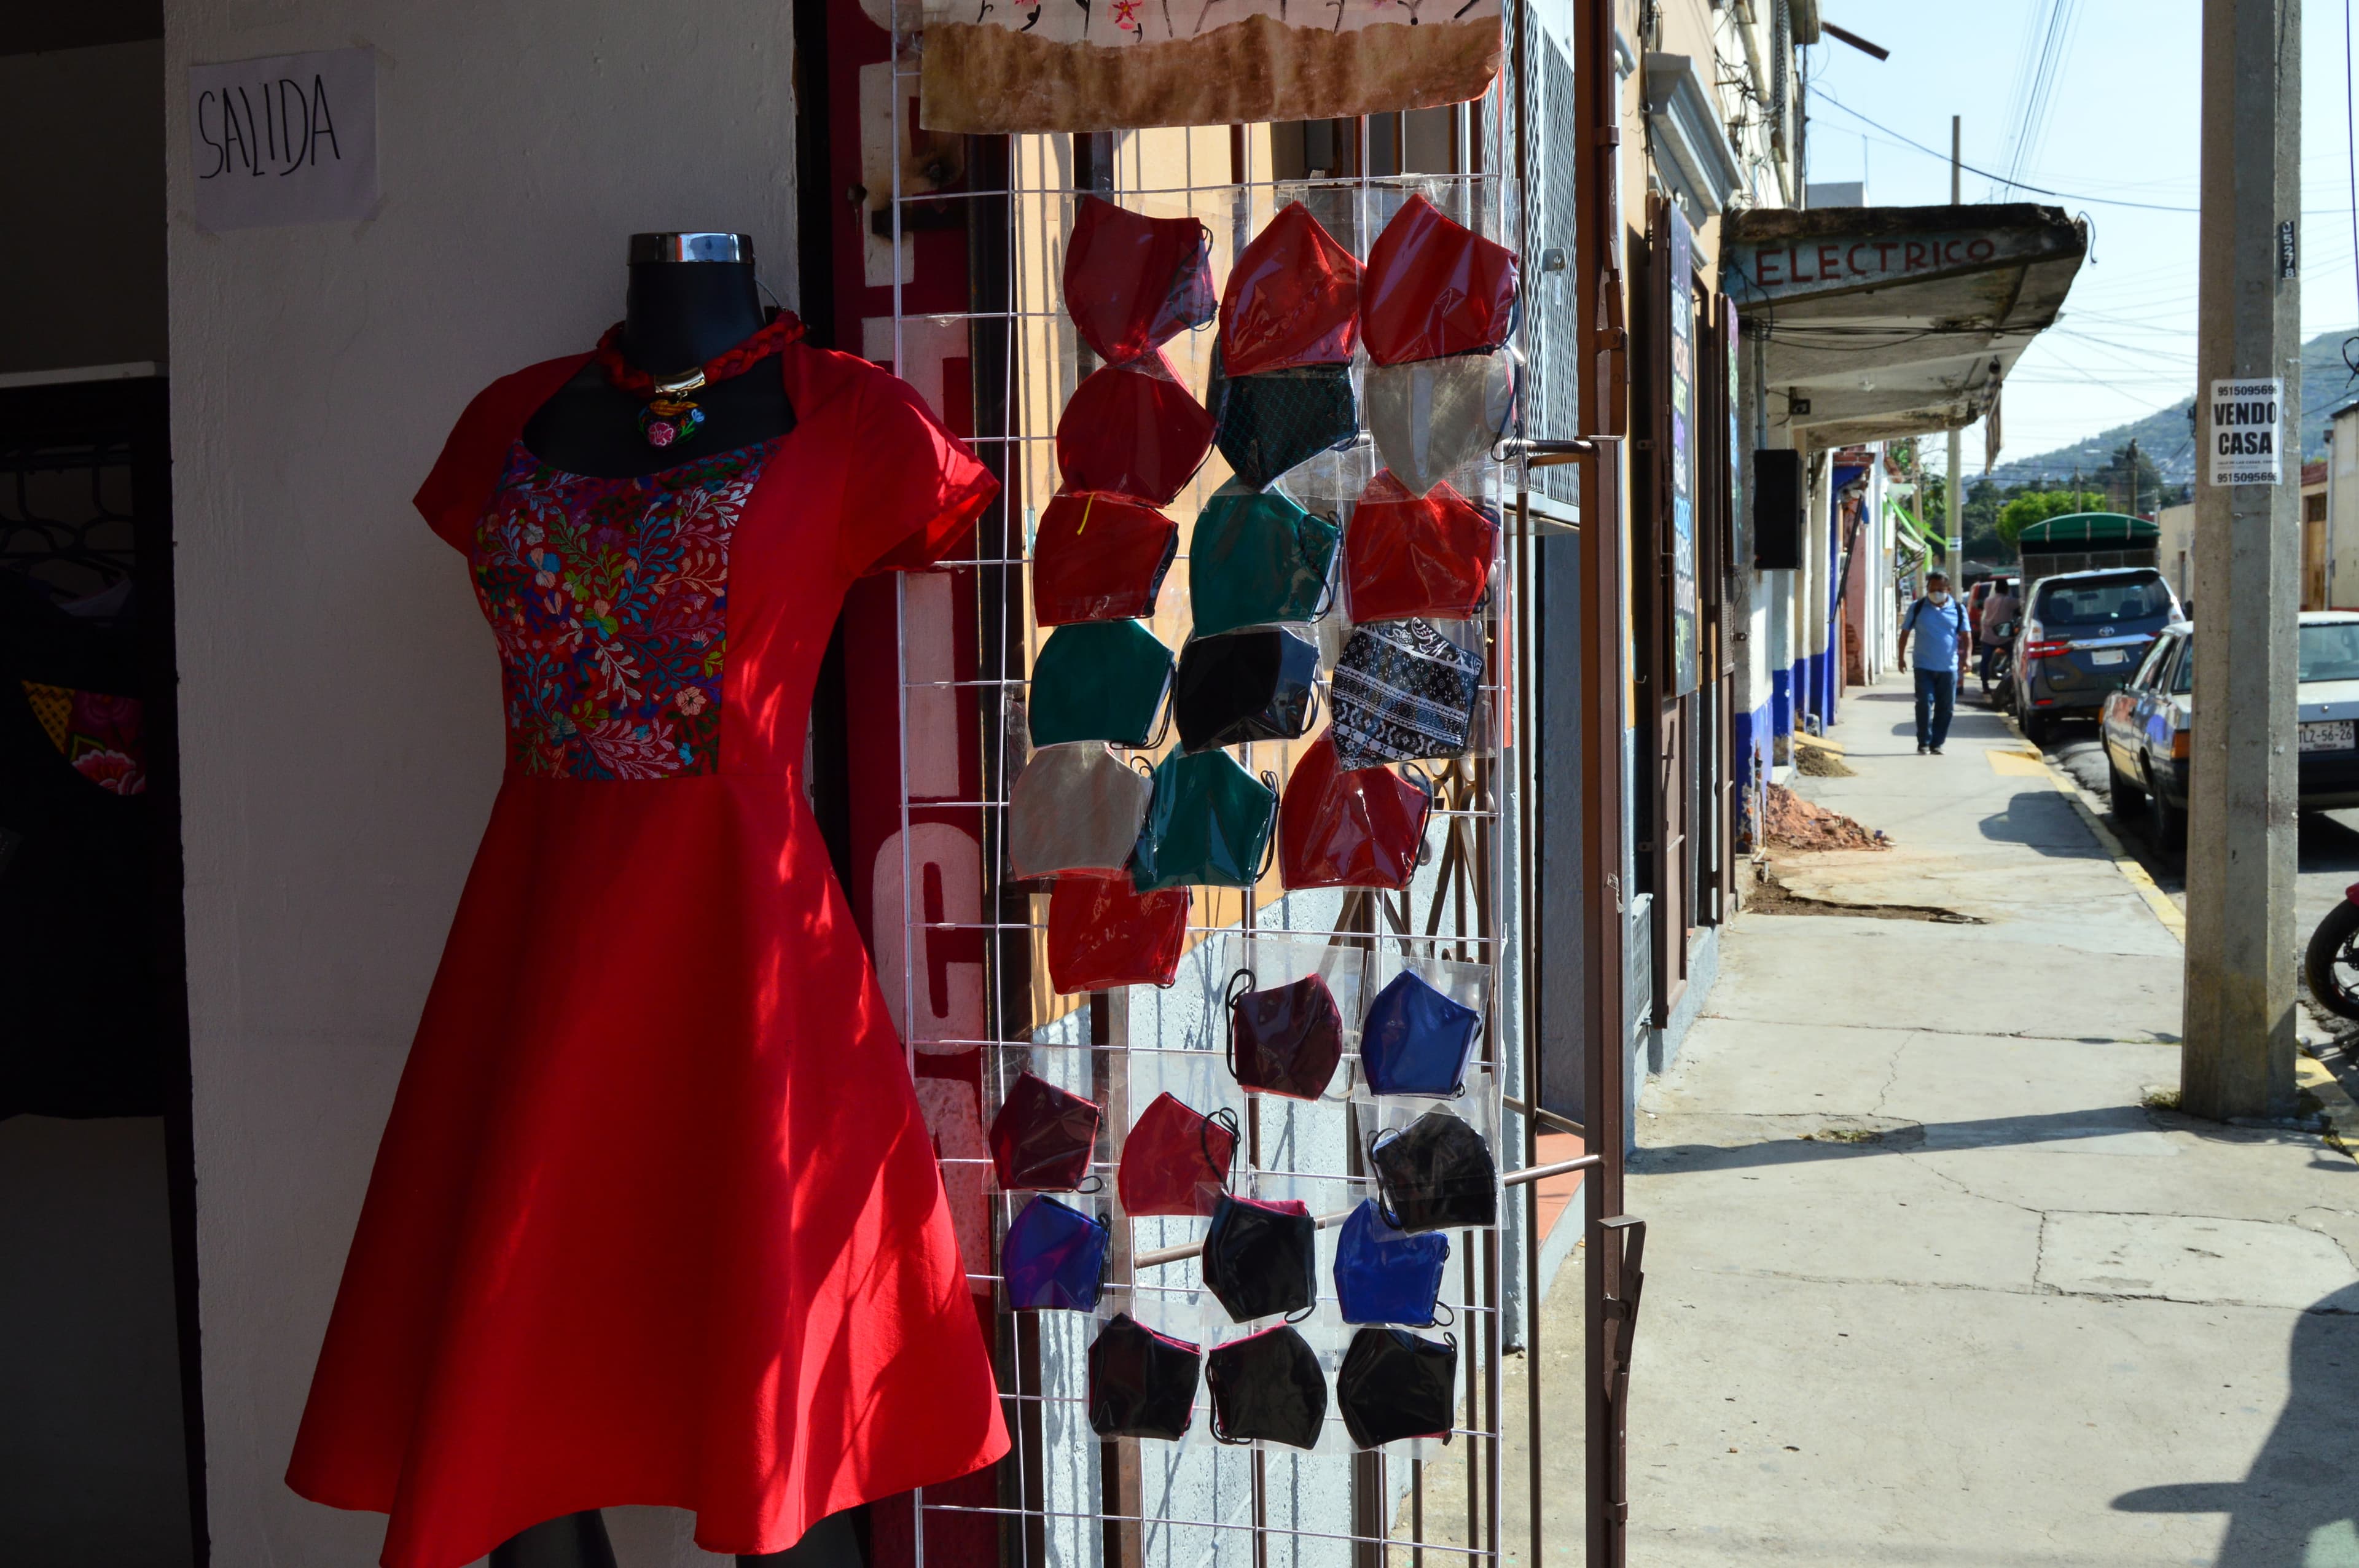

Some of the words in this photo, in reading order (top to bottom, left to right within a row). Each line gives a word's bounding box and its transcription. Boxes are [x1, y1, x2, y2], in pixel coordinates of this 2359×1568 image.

[198, 74, 341, 179] SALIDA
[1755, 238, 1995, 286] ELECTRICO
[2213, 401, 2277, 426] VENDO
[2218, 432, 2272, 455] CASA
